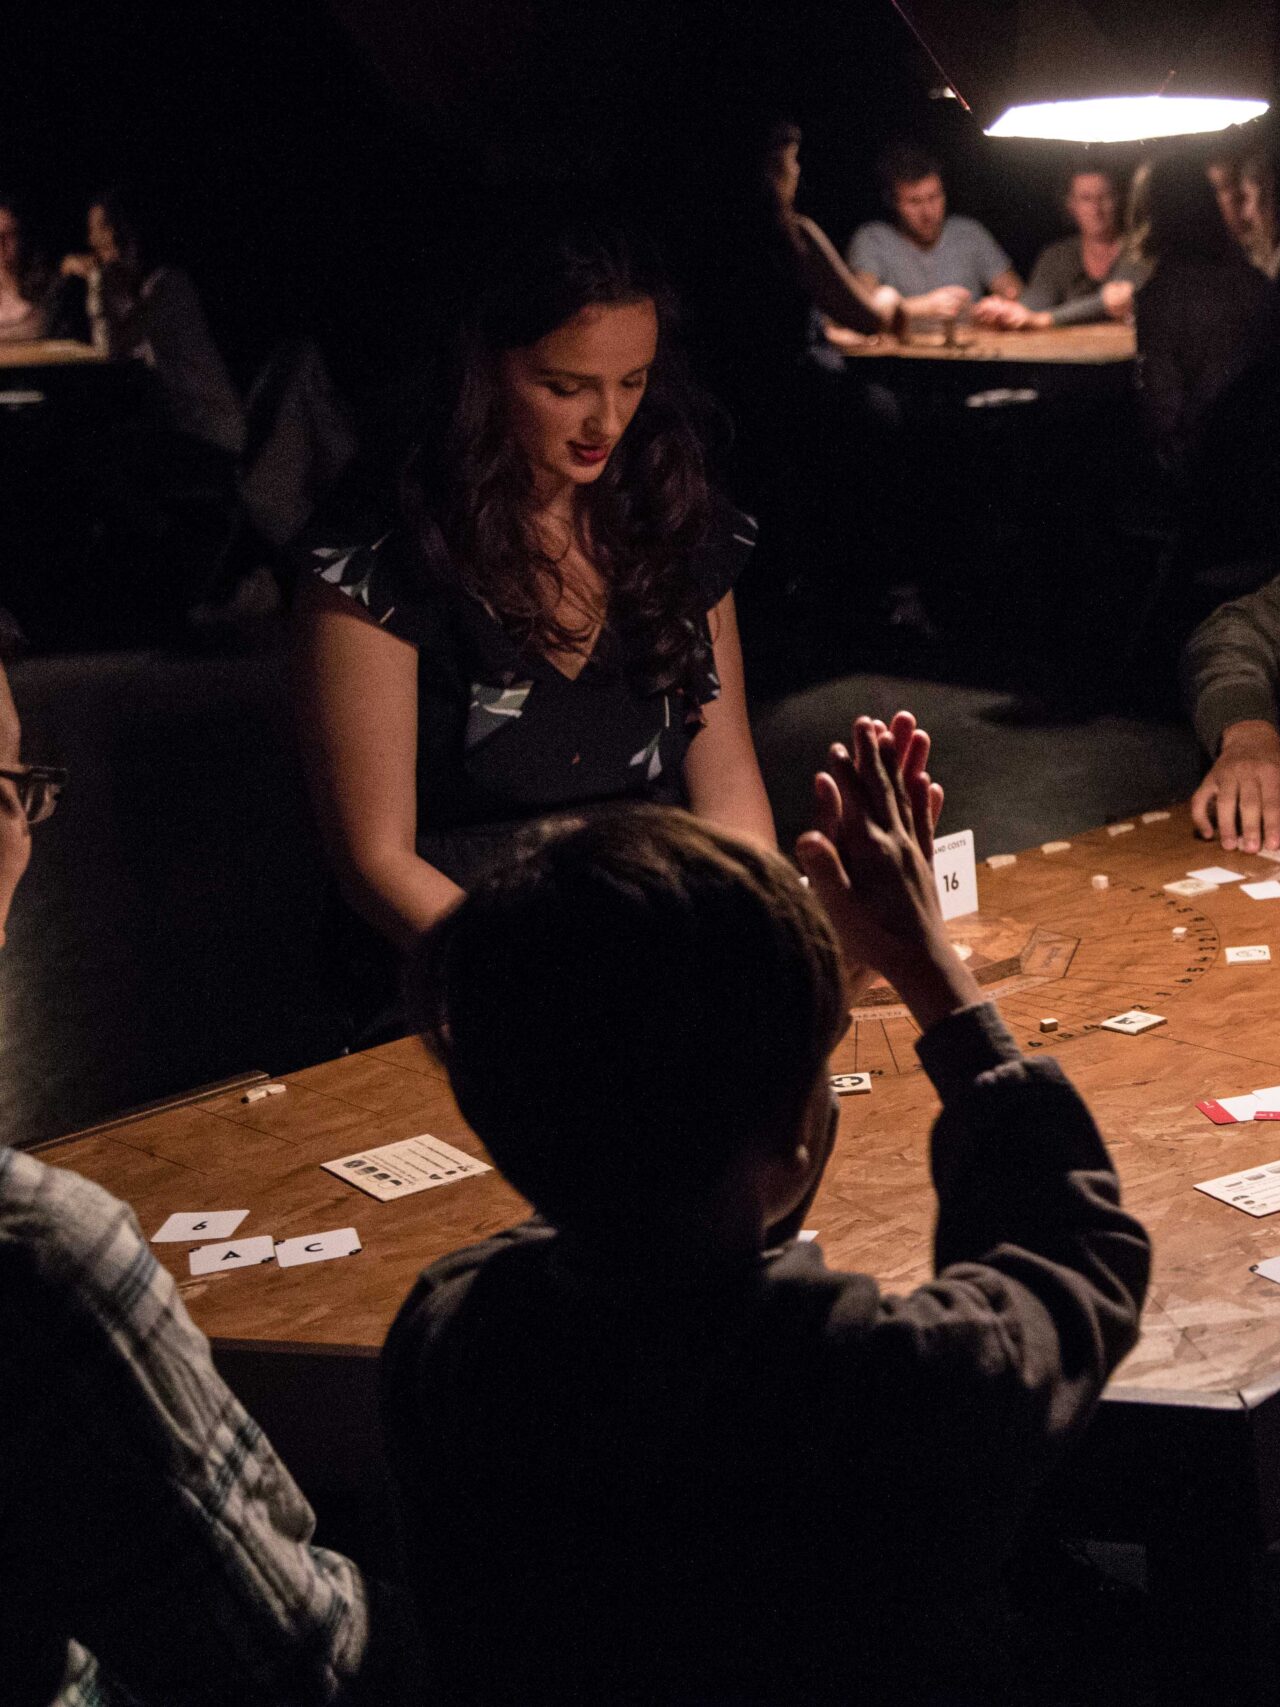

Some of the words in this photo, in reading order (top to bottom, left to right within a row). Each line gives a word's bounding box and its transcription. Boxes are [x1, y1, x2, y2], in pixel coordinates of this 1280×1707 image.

[943, 871, 960, 893] 16
[192, 1221, 208, 1231] 6
[304, 1243, 324, 1253] C
[221, 1250, 242, 1261] A
